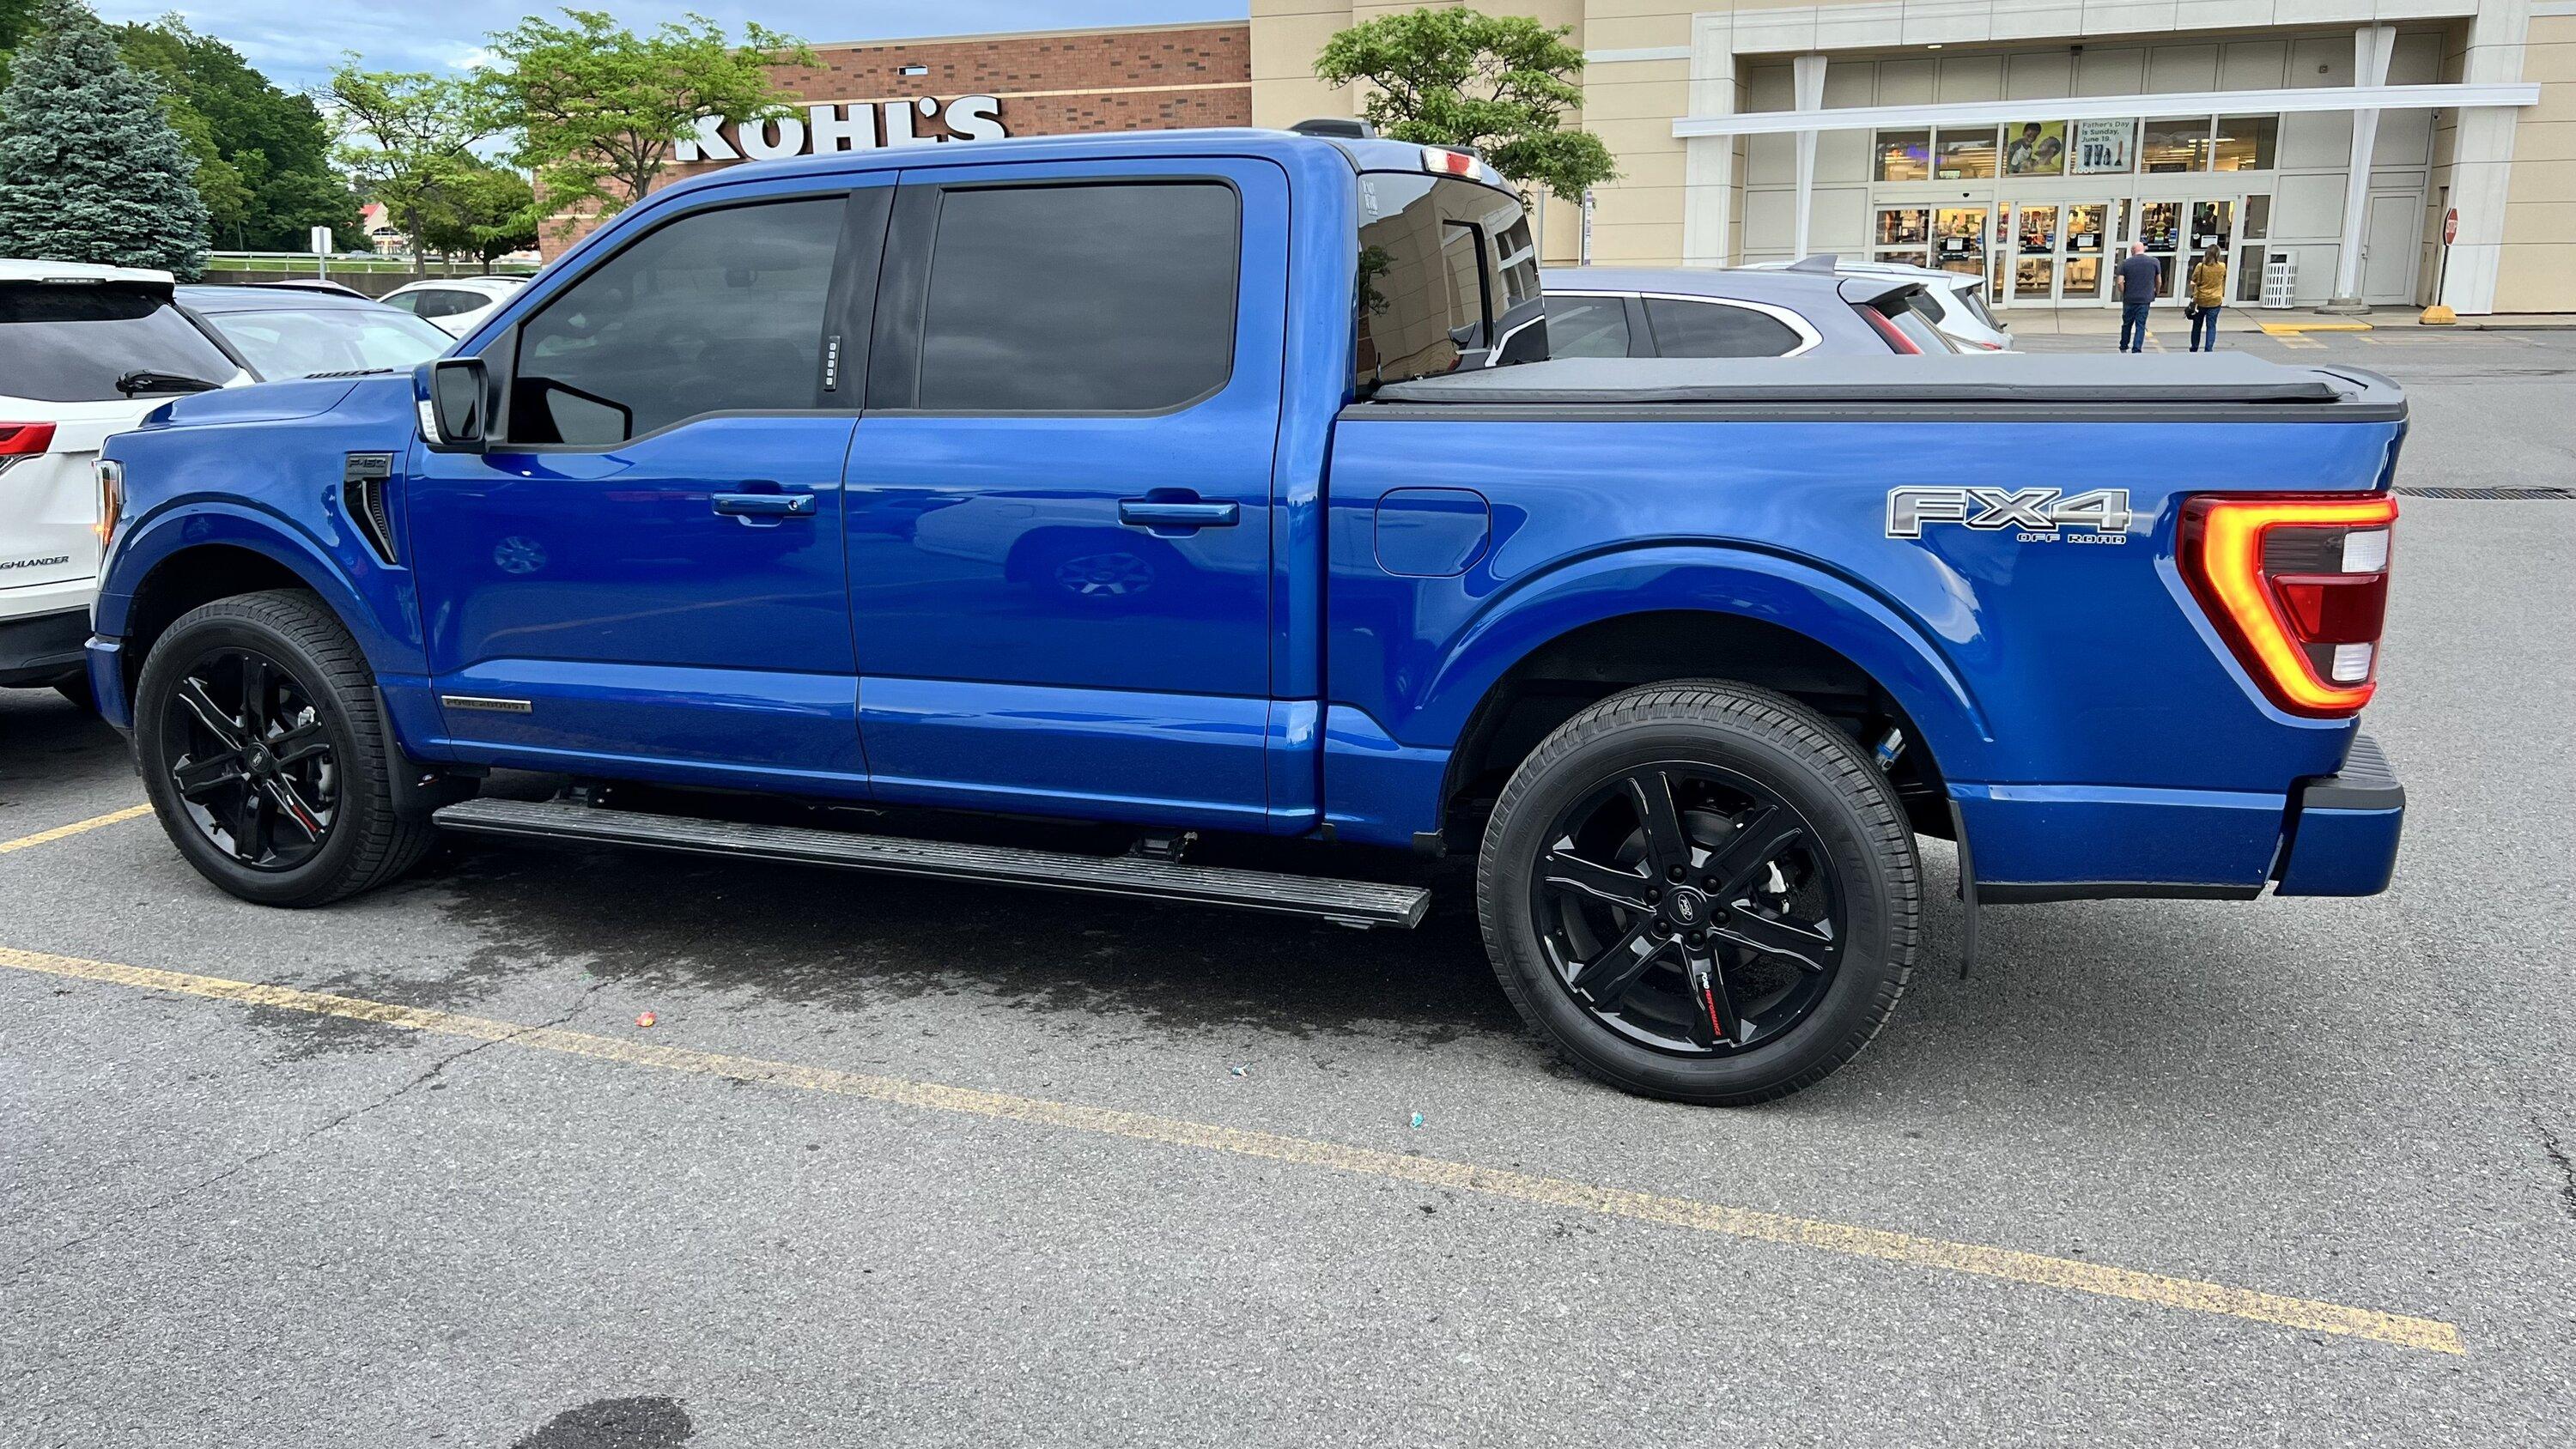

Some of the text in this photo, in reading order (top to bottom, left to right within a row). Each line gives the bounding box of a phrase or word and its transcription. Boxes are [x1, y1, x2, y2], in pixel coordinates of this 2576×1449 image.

[674, 94, 1006, 161] KOHL'S
[1886, 486, 2132, 538] FX4
[2016, 532, 2128, 545] OFF ROAD
